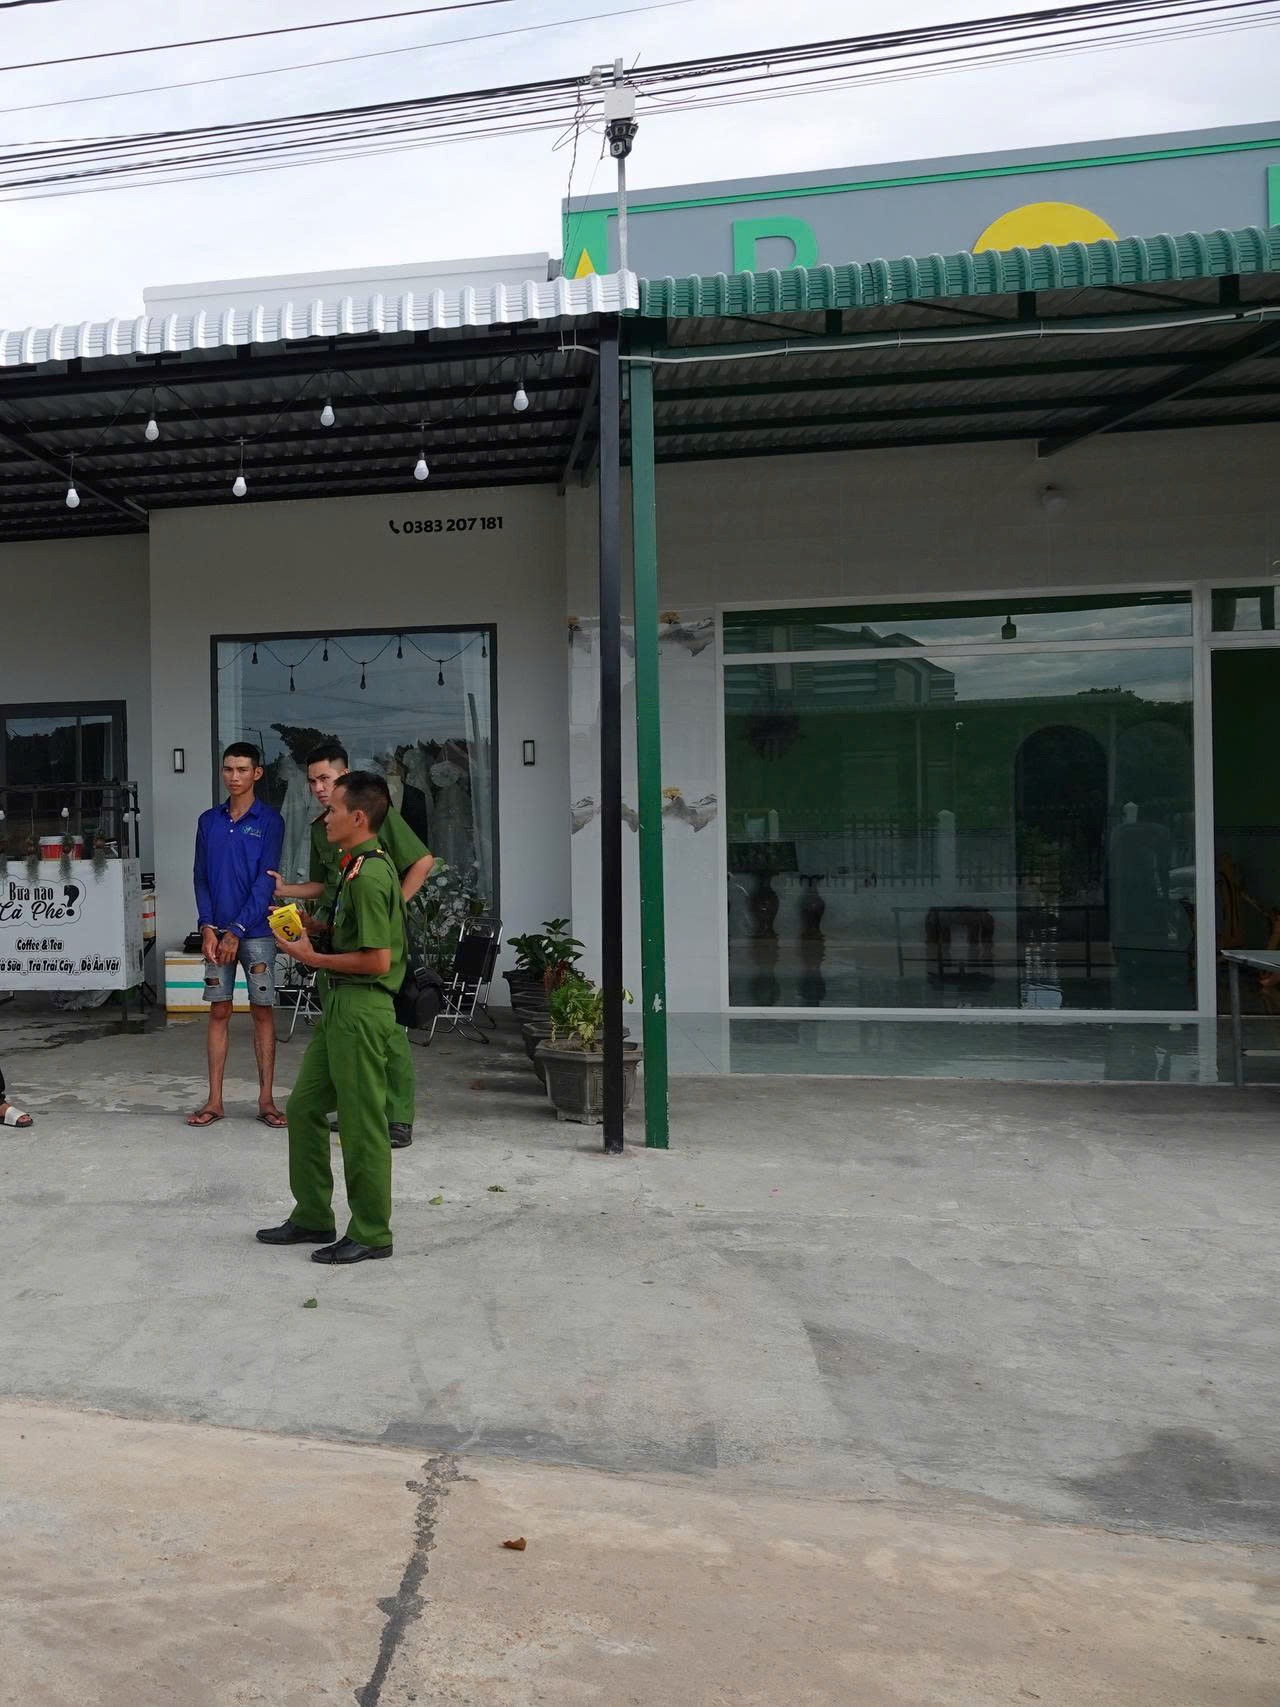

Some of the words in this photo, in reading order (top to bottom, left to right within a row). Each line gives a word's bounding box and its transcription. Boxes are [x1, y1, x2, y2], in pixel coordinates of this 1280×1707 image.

[403, 519, 443, 534] 0383
[446, 518, 477, 532] 207
[480, 516, 503, 530] 181
[0, 901, 23, 921] Cà
[31, 901, 67, 921] Phê
[17, 939, 39, 951] Coffee
[41, 940, 48, 951] &
[50, 939, 63, 951] Tea
[60, 959, 74, 974] Cây
